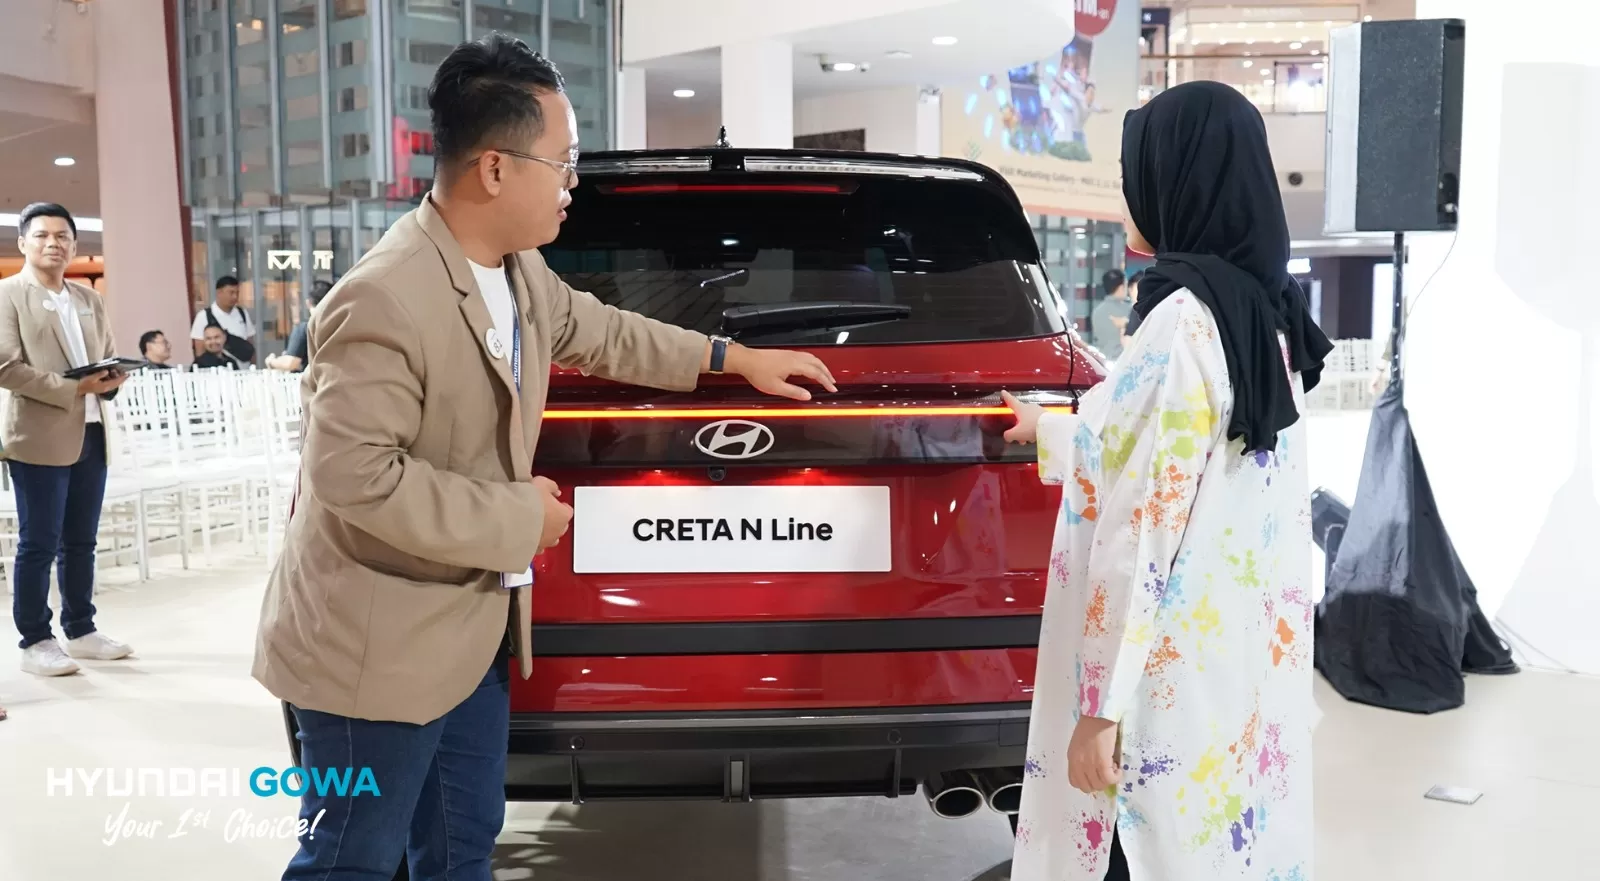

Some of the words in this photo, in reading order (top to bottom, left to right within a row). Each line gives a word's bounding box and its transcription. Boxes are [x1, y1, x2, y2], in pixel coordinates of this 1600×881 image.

[1017, 168, 1050, 180] Marketing
[632, 518, 734, 542] CRETA
[740, 518, 762, 541] N
[771, 517, 834, 542] Line
